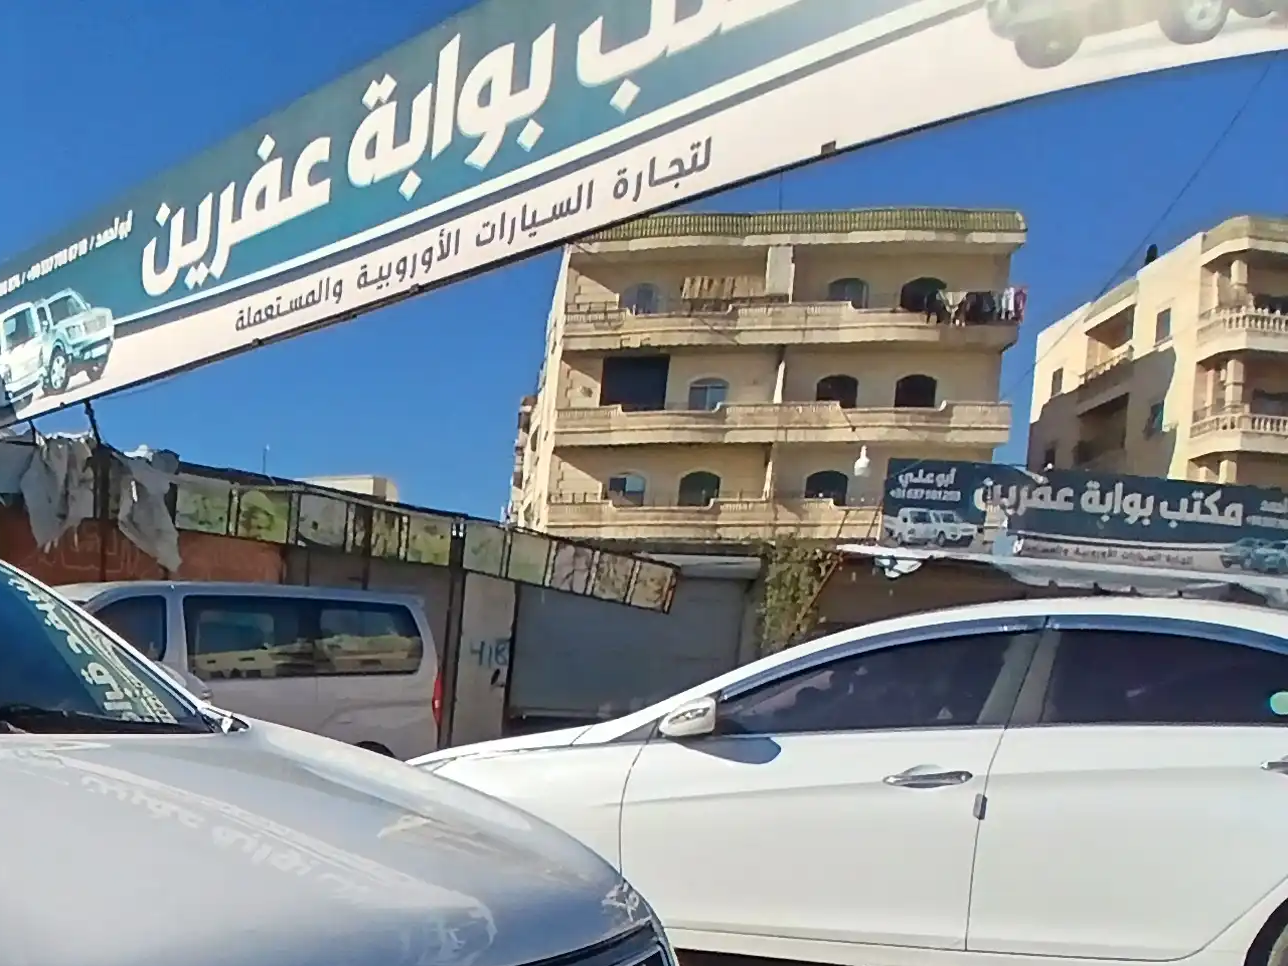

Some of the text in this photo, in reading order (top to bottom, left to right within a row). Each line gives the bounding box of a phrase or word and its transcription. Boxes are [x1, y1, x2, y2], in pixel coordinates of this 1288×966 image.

[347, 22, 556, 201] بوابة
[142, 134, 331, 297] عفرين
[235, 135, 713, 332] لتجارة السيارات الأوروبية والمستعملة
[1080, 480, 1155, 525] بوابة
[1159, 489, 1244, 529] مكتب
